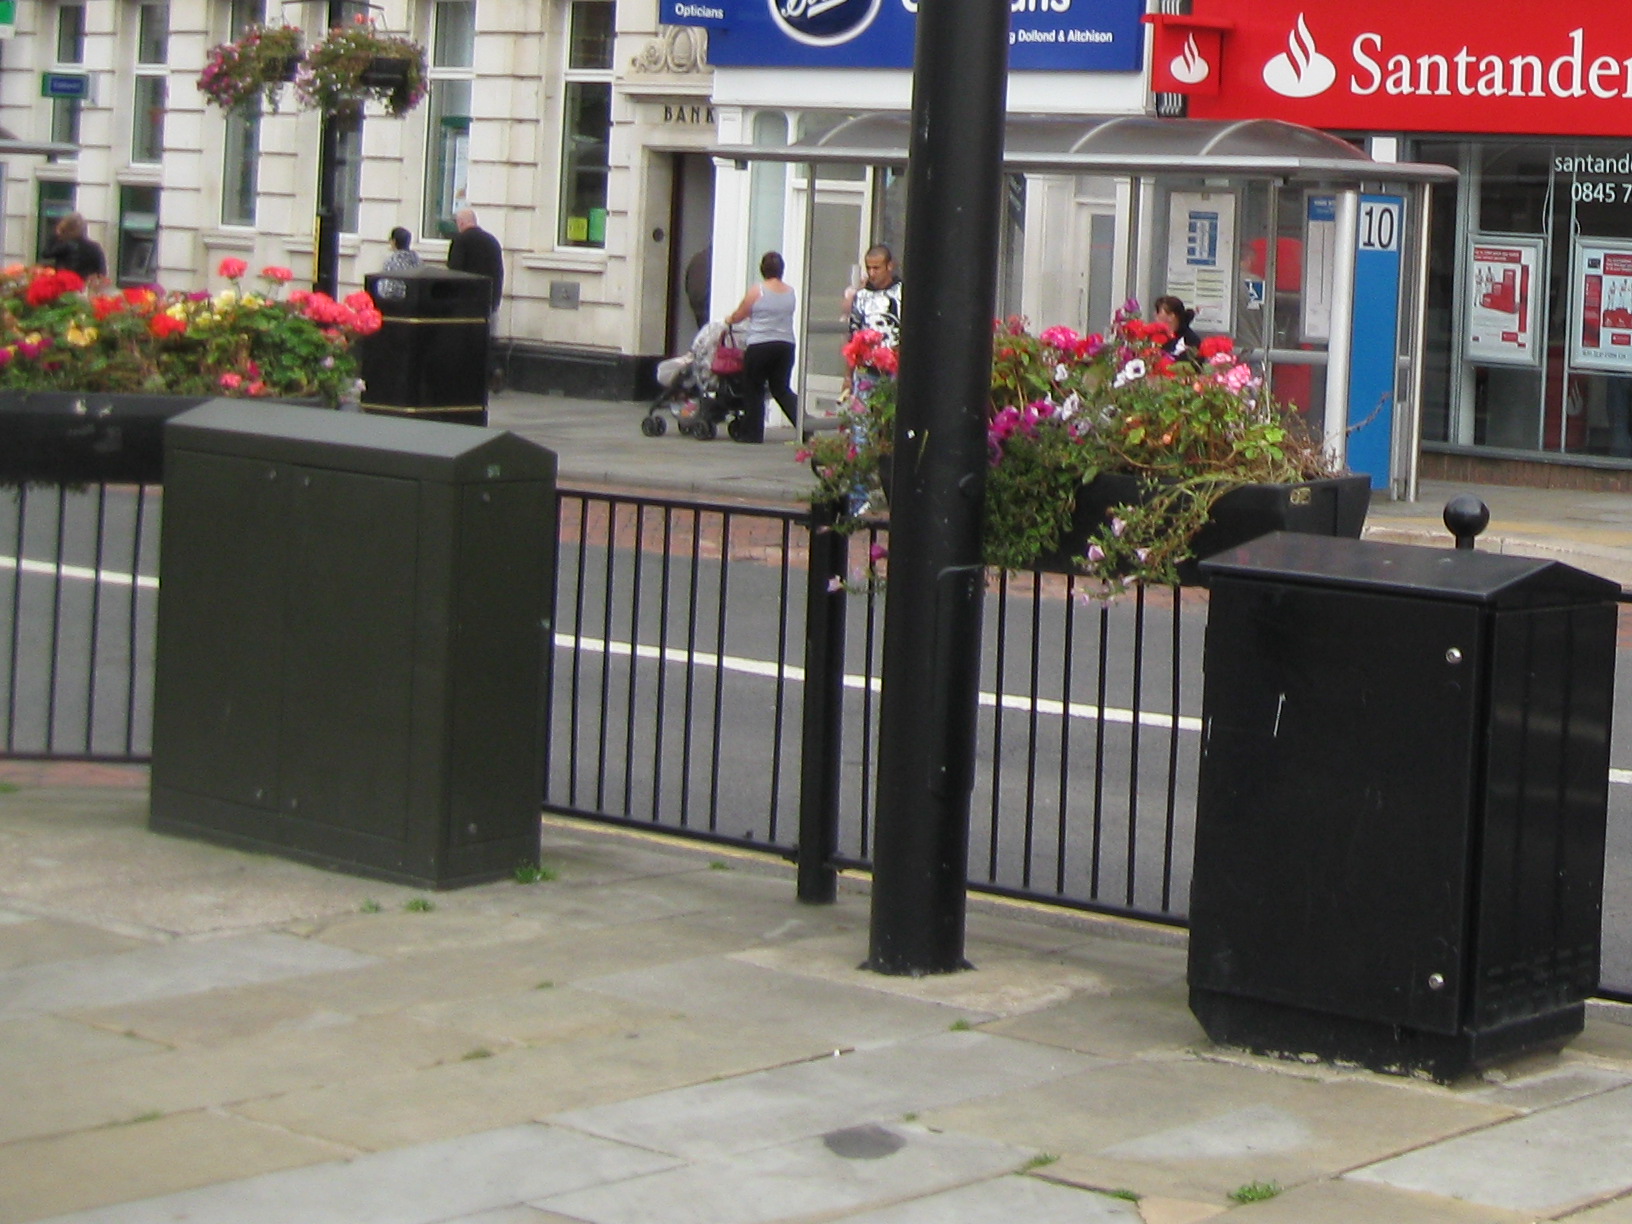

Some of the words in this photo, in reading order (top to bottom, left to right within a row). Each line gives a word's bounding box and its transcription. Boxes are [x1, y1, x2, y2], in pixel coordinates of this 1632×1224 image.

[674, 2, 724, 20] Opticians
[1067, 29, 1113, 43] Aitchison
[664, 104, 715, 124] BANK
[1571, 183, 1616, 203] 0845
[1362, 206, 1395, 250] 10
